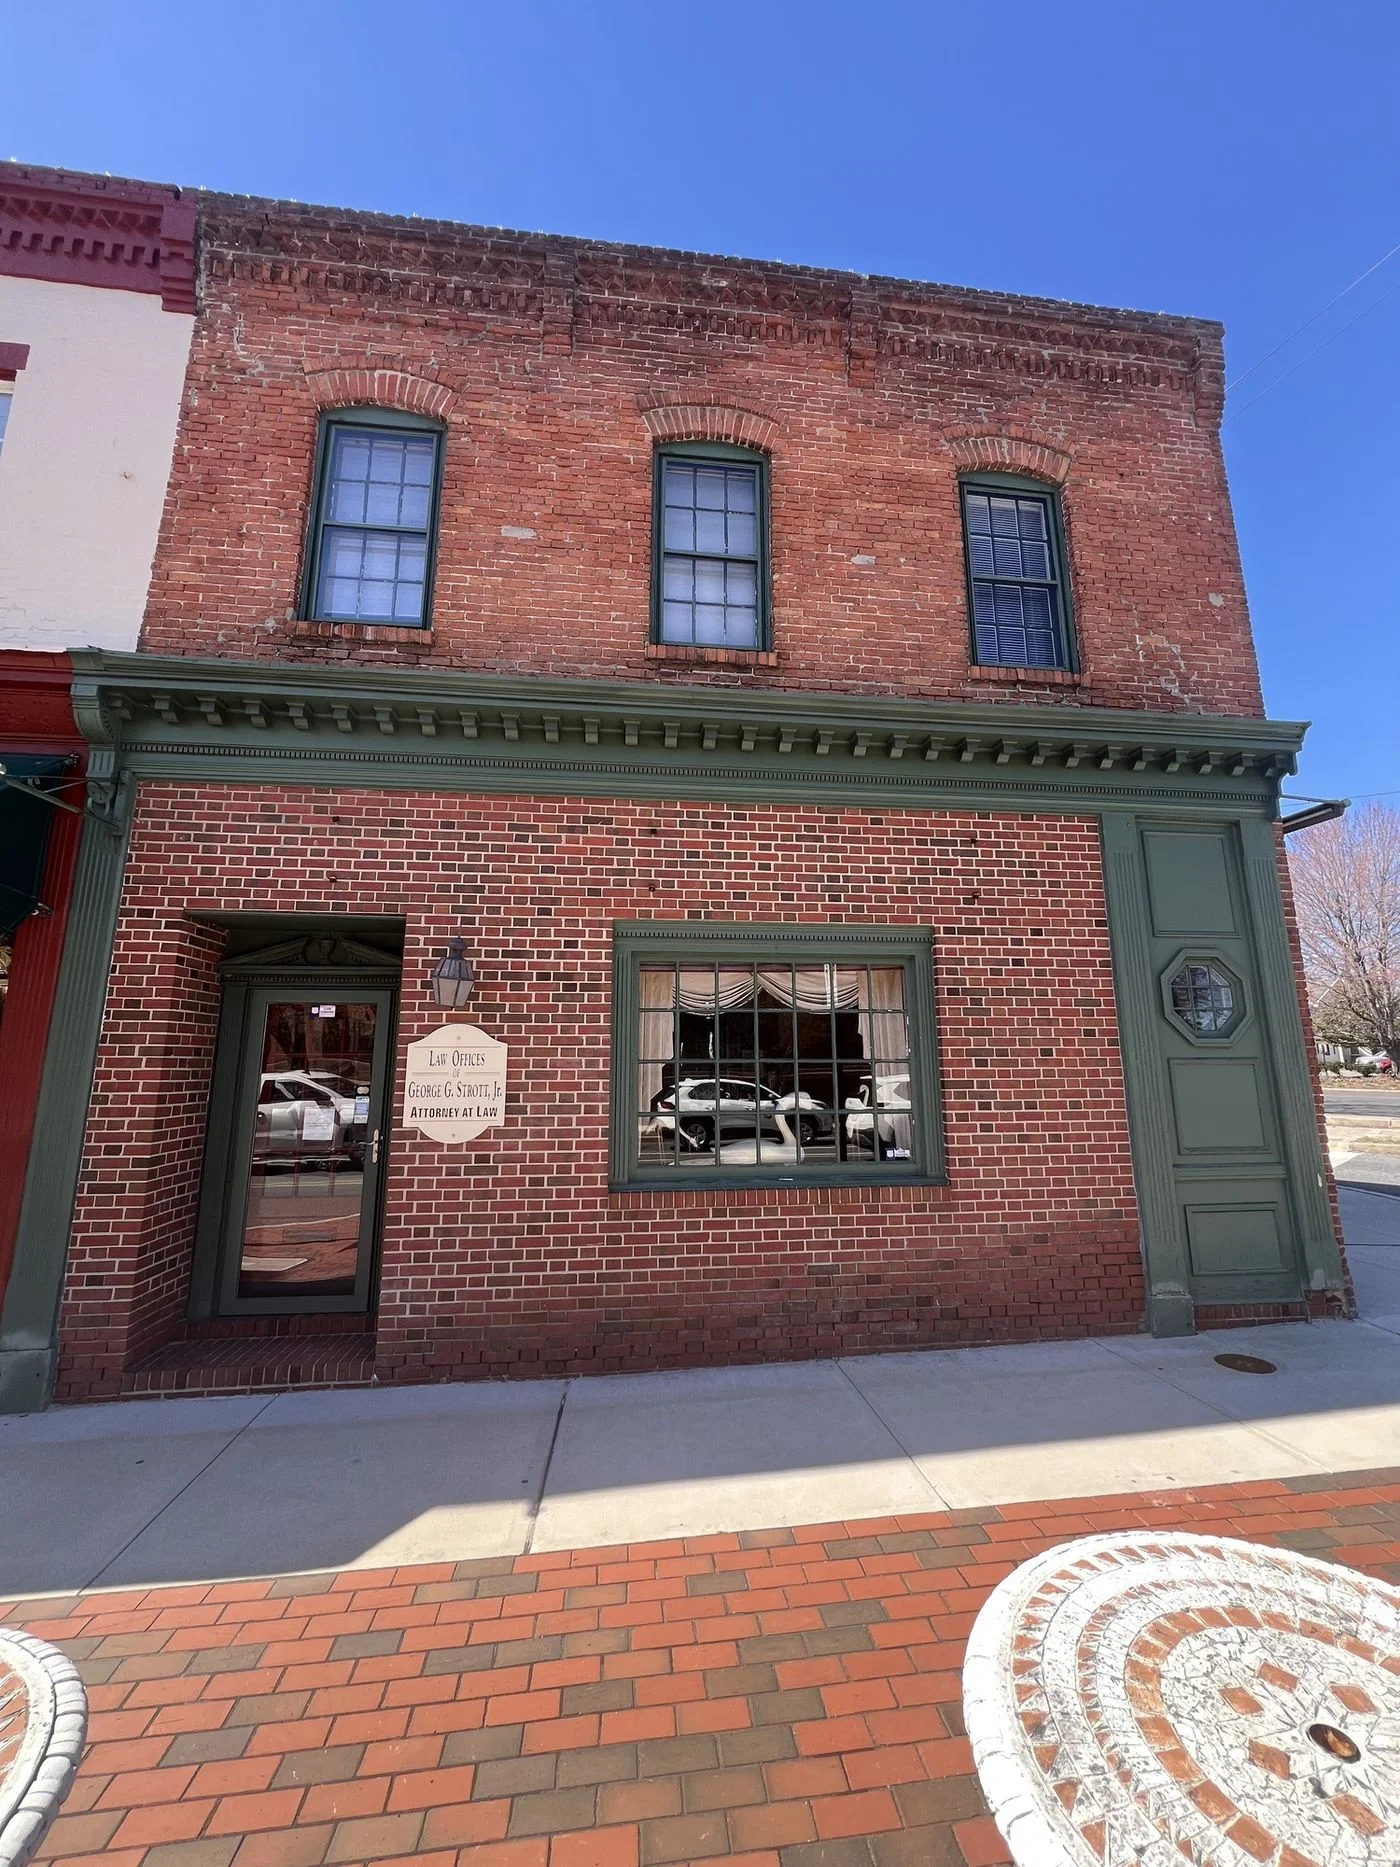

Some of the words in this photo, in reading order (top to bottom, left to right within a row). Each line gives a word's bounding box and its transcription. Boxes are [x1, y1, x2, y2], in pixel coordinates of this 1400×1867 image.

[429, 1050, 447, 1066] LAW
[452, 1049, 486, 1066] OFFICES
[408, 1081, 442, 1098] GEORGE
[444, 1081, 454, 1098] G.
[456, 1081, 491, 1100] STROTT,
[492, 1081, 502, 1101] Jr.
[410, 1106, 460, 1118] ATTORNEY
[462, 1107, 473, 1117] AT
[476, 1105, 498, 1117] LAW
